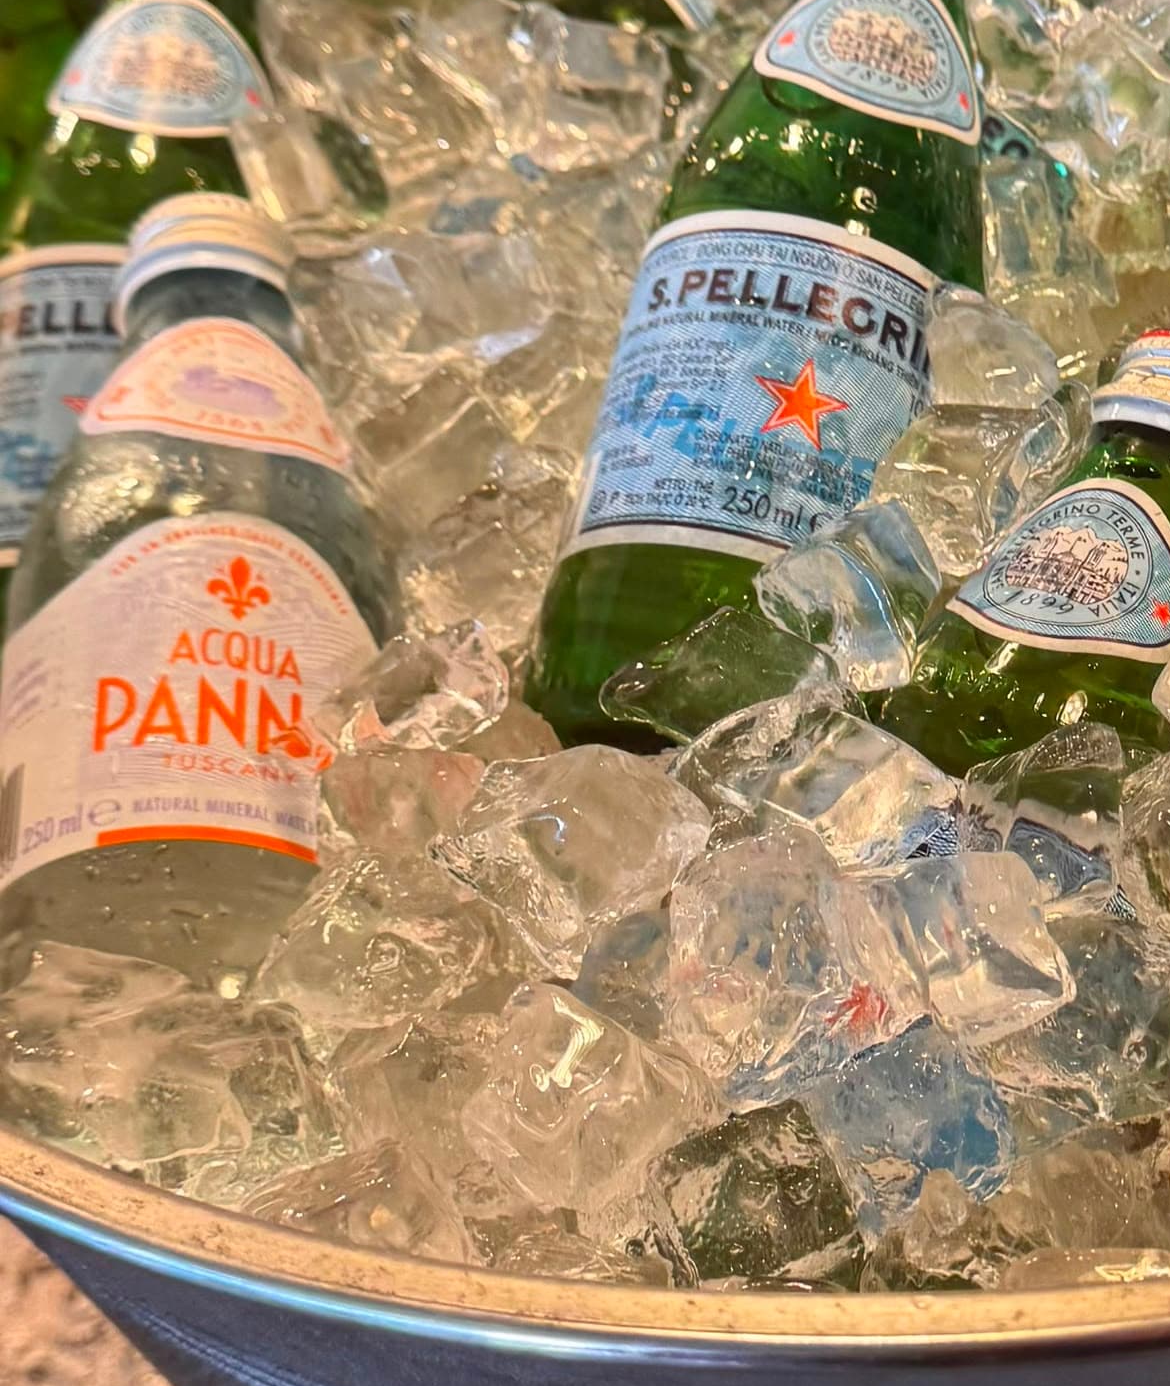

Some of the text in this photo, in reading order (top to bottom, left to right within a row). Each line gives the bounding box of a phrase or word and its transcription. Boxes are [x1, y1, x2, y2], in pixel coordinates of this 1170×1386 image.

[721, 485, 772, 520] 250
[773, 505, 804, 532] ml
[1105, 509, 1146, 560] TERME
[1003, 590, 1075, 615] 1899
[1087, 581, 1142, 618] ITALIA
[169, 627, 302, 685] ACQUA
[163, 752, 298, 786] TUSCANY
[23, 819, 52, 856] 250
[58, 803, 84, 835] ml
[132, 796, 201, 815] NATURAL
[205, 799, 269, 822] MINERAL
